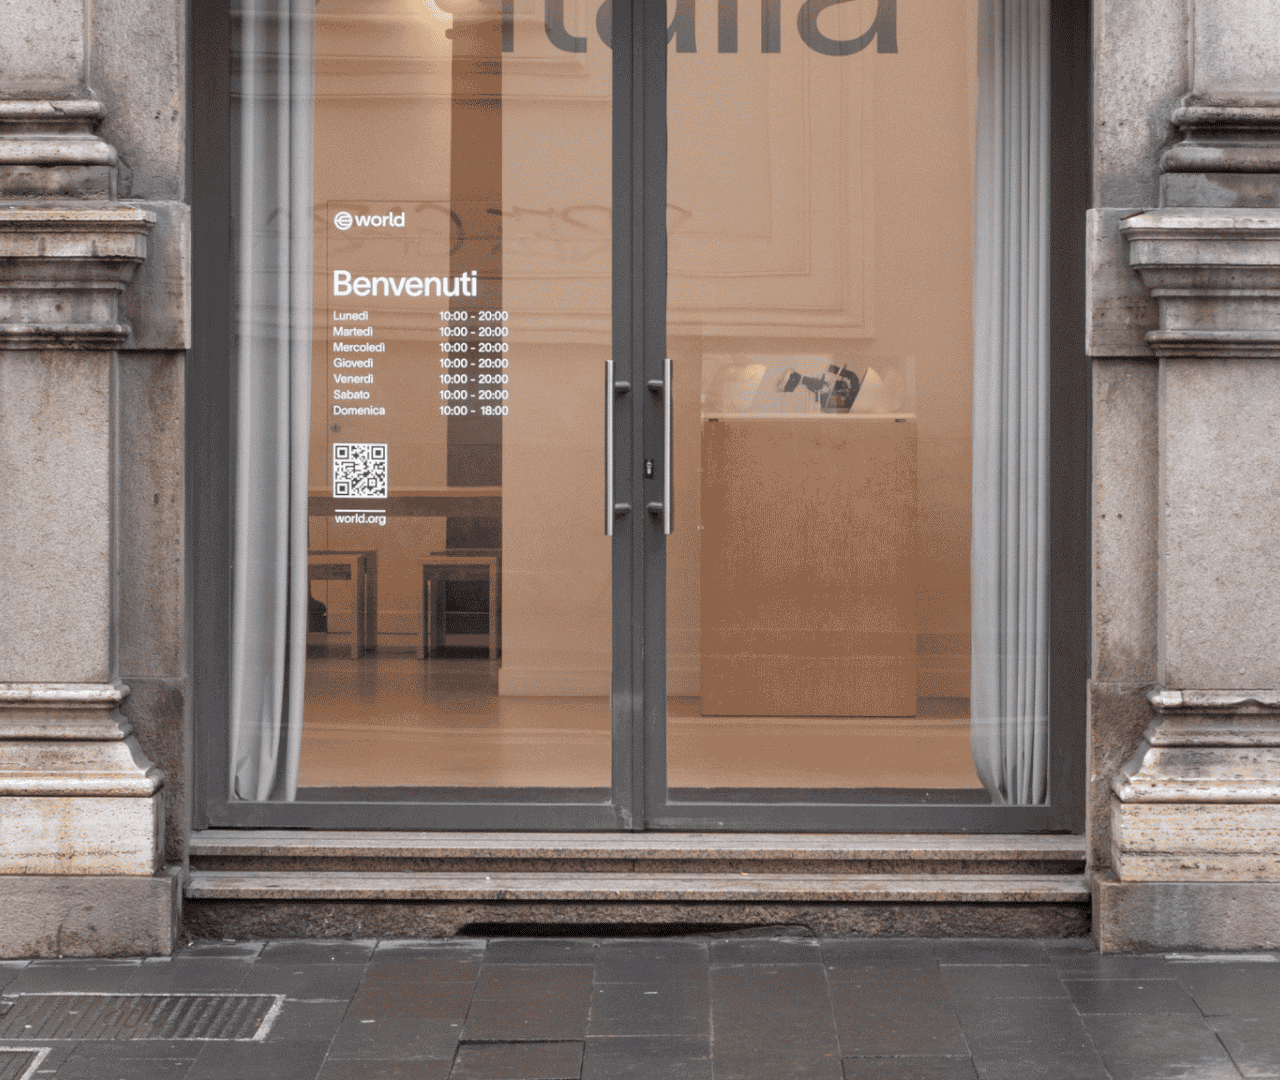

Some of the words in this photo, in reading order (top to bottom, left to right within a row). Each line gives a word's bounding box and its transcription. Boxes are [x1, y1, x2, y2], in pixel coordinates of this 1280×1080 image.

[354, 211, 406, 227] world
[333, 269, 477, 297] Benvenuti
[332, 311, 369, 321] Lunedì
[439, 311, 468, 321] 10:00
[478, 311, 509, 321] 20:00
[332, 327, 373, 337] Martedì
[439, 327, 468, 337] 10:00
[478, 327, 509, 337] 20:00
[332, 342, 385, 352] Mercoledì
[439, 342, 468, 352] 10:00
[478, 342, 509, 352] 20:00
[332, 358, 373, 368] Giovedì
[439, 358, 468, 368] 10:00
[478, 358, 509, 368] 20:00
[332, 374, 373, 384] Venerdì
[439, 374, 468, 384] 10:00
[478, 374, 509, 384] 20:00
[332, 389, 370, 399] Sabato
[439, 389, 468, 399] 10:00
[478, 389, 509, 399] 20:00
[332, 405, 385, 415] Domenica
[439, 405, 468, 415] 10:00
[481, 405, 509, 415] 18:00
[335, 513, 387, 526] world.org
